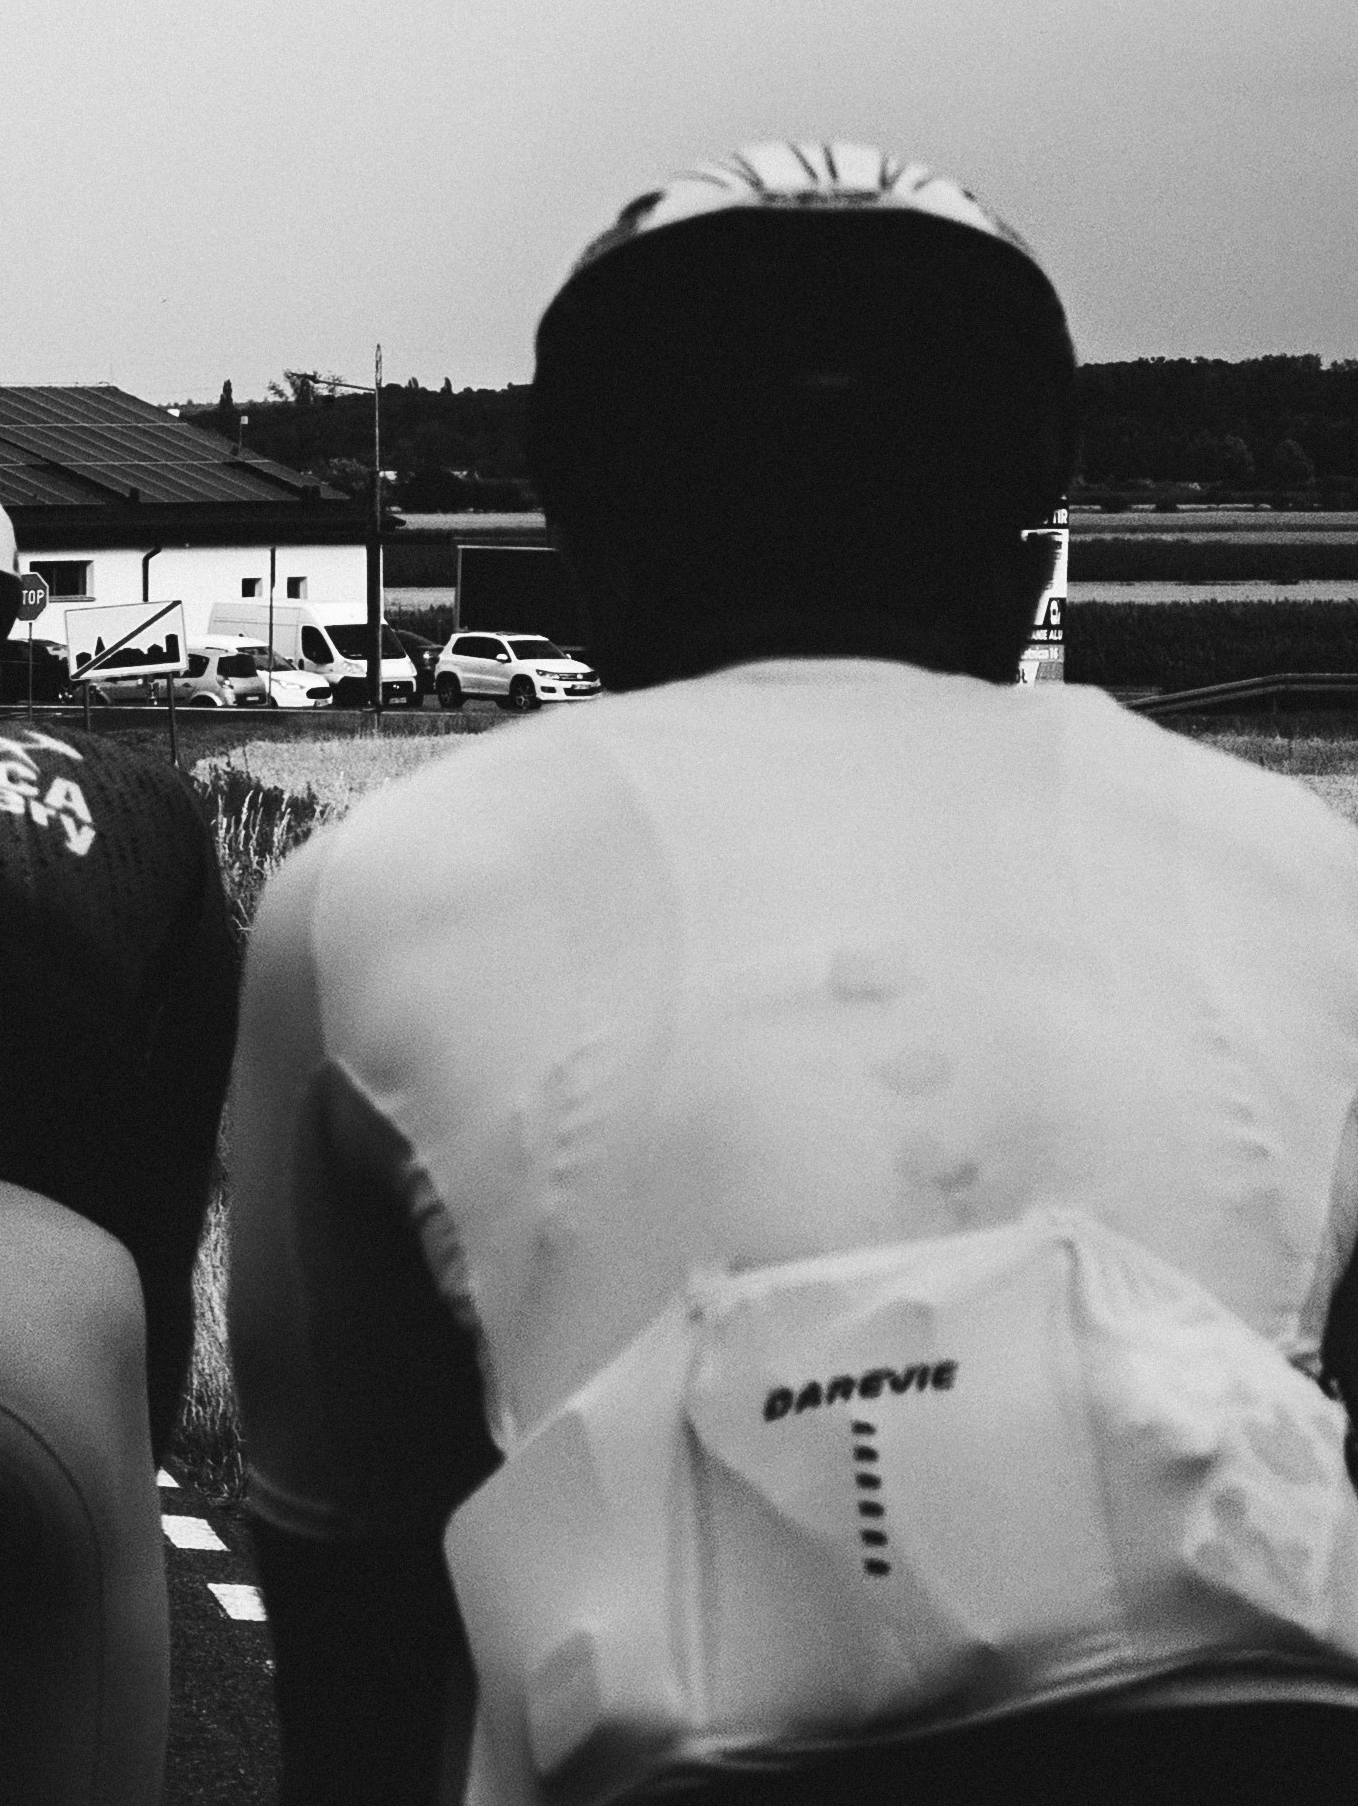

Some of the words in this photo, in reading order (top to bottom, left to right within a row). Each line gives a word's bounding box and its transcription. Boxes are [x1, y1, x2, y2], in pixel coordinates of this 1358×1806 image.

[22, 589, 46, 605] TOP
[1048, 629, 1064, 641] ALU
[762, 1359, 960, 1423] DAREVIE
